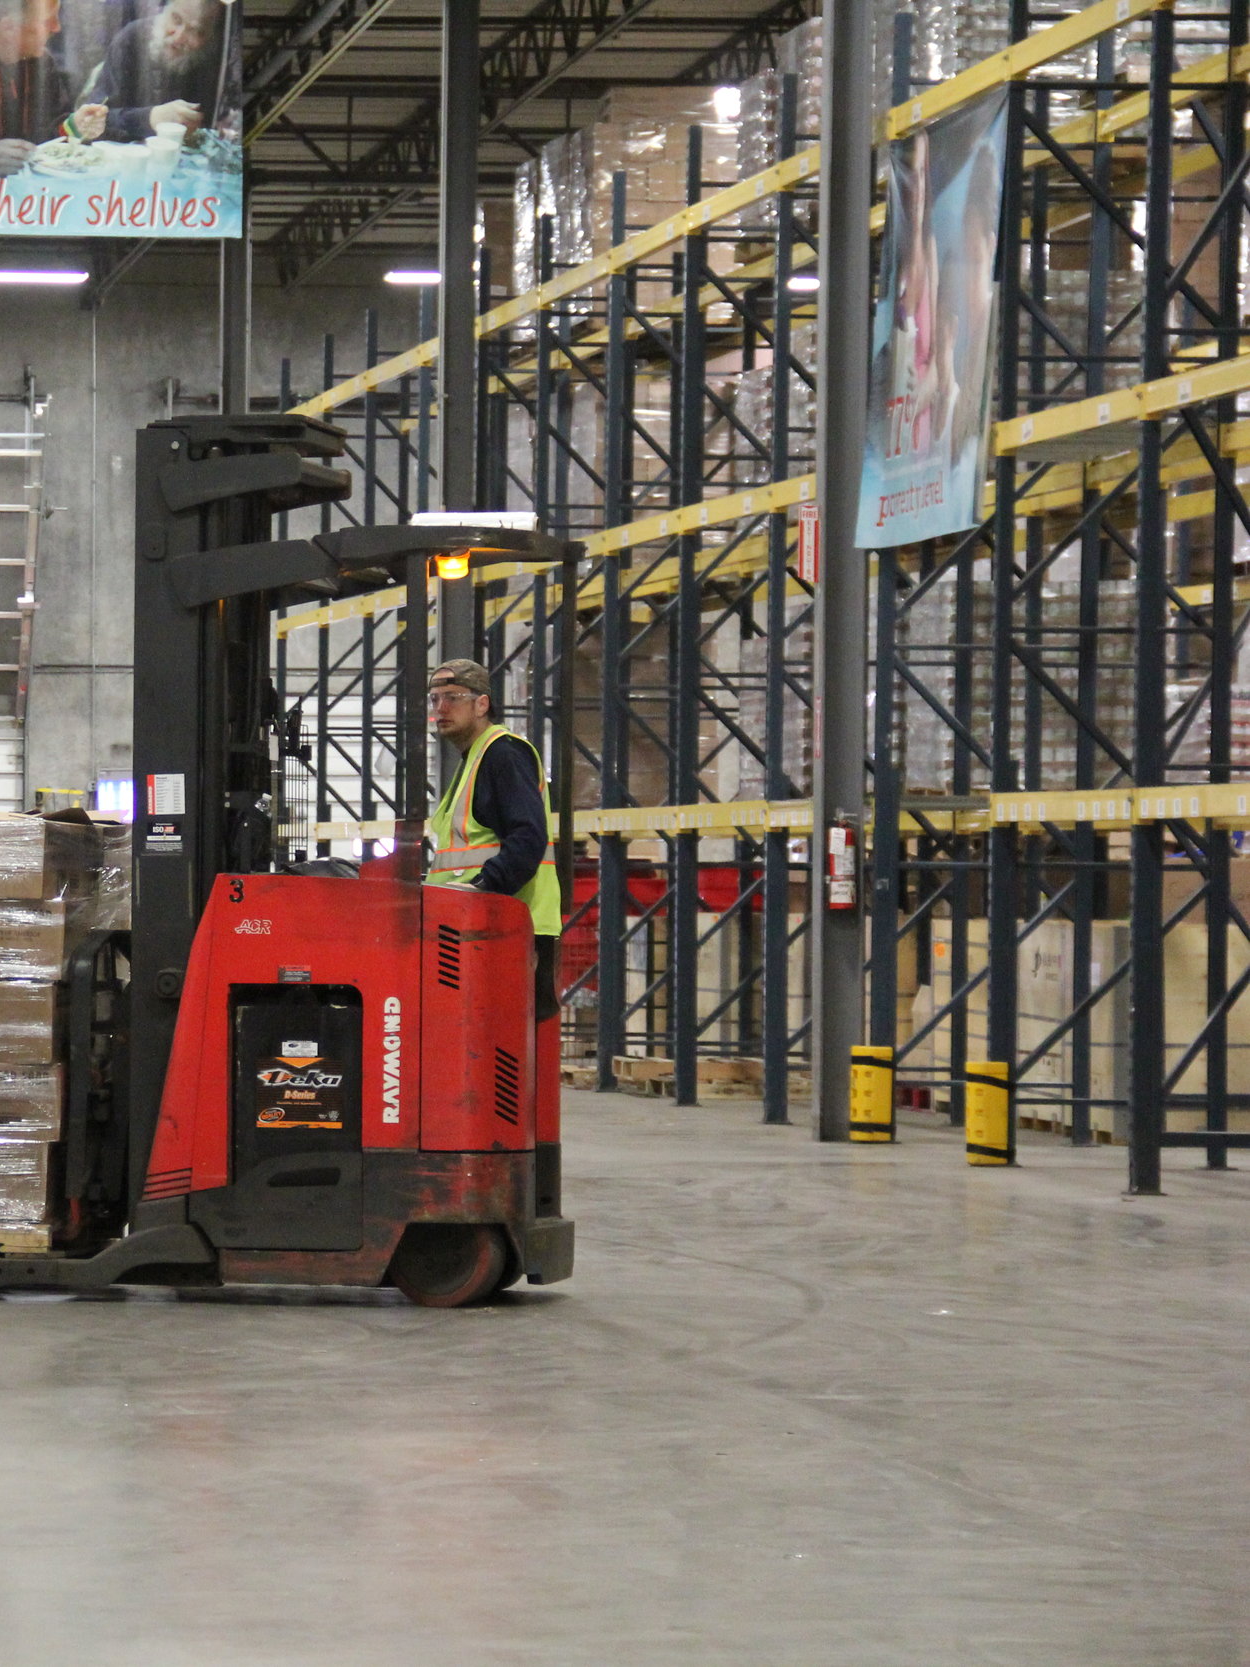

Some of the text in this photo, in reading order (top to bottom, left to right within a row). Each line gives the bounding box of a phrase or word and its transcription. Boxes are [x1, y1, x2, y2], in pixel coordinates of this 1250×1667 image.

[86, 179, 221, 228] shelves
[802, 510, 818, 519] FIRE
[229, 879, 245, 903] 3
[234, 919, 272, 935] ACR
[382, 996, 401, 1124] RAYMOND
[257, 1068, 342, 1088] Deka
